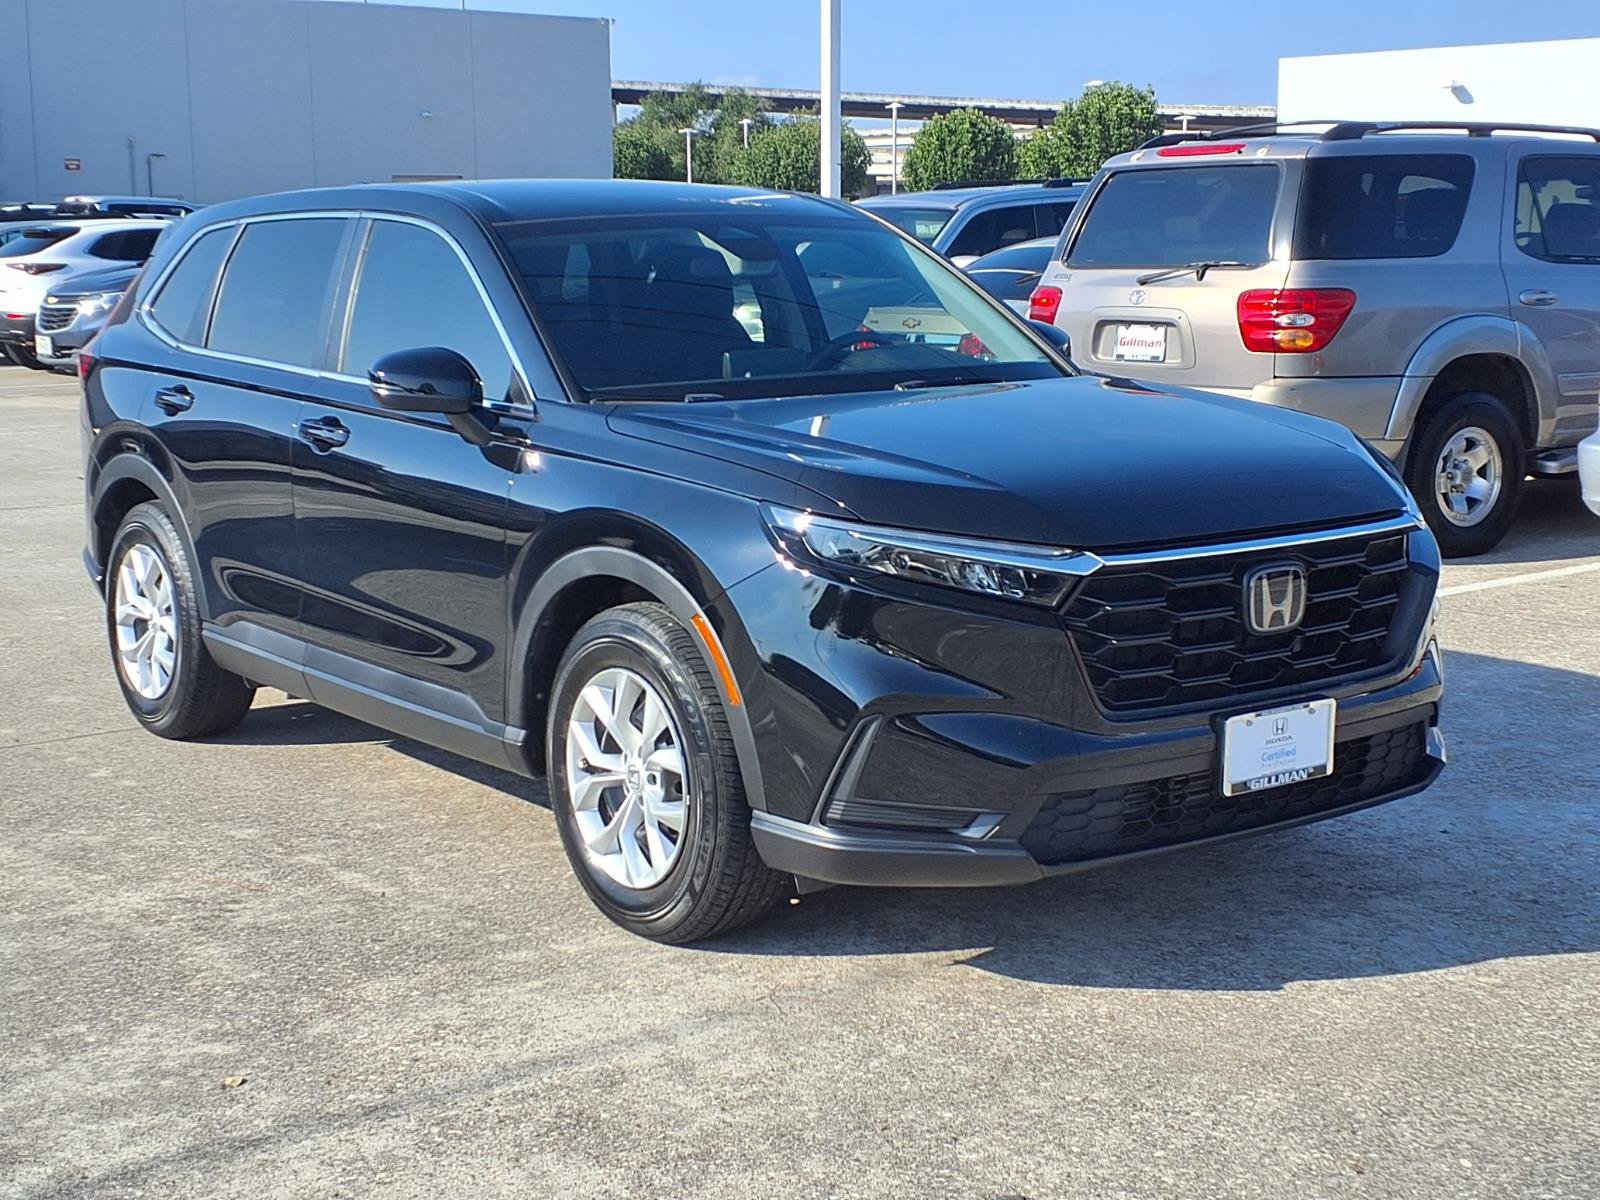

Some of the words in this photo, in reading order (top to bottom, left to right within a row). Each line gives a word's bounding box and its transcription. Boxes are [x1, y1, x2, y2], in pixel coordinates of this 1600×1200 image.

[1119, 336, 1162, 348] Gillman
[1265, 735, 1293, 745] HONDA
[1261, 747, 1297, 762] Certified
[1250, 769, 1308, 790] GILLMAN
